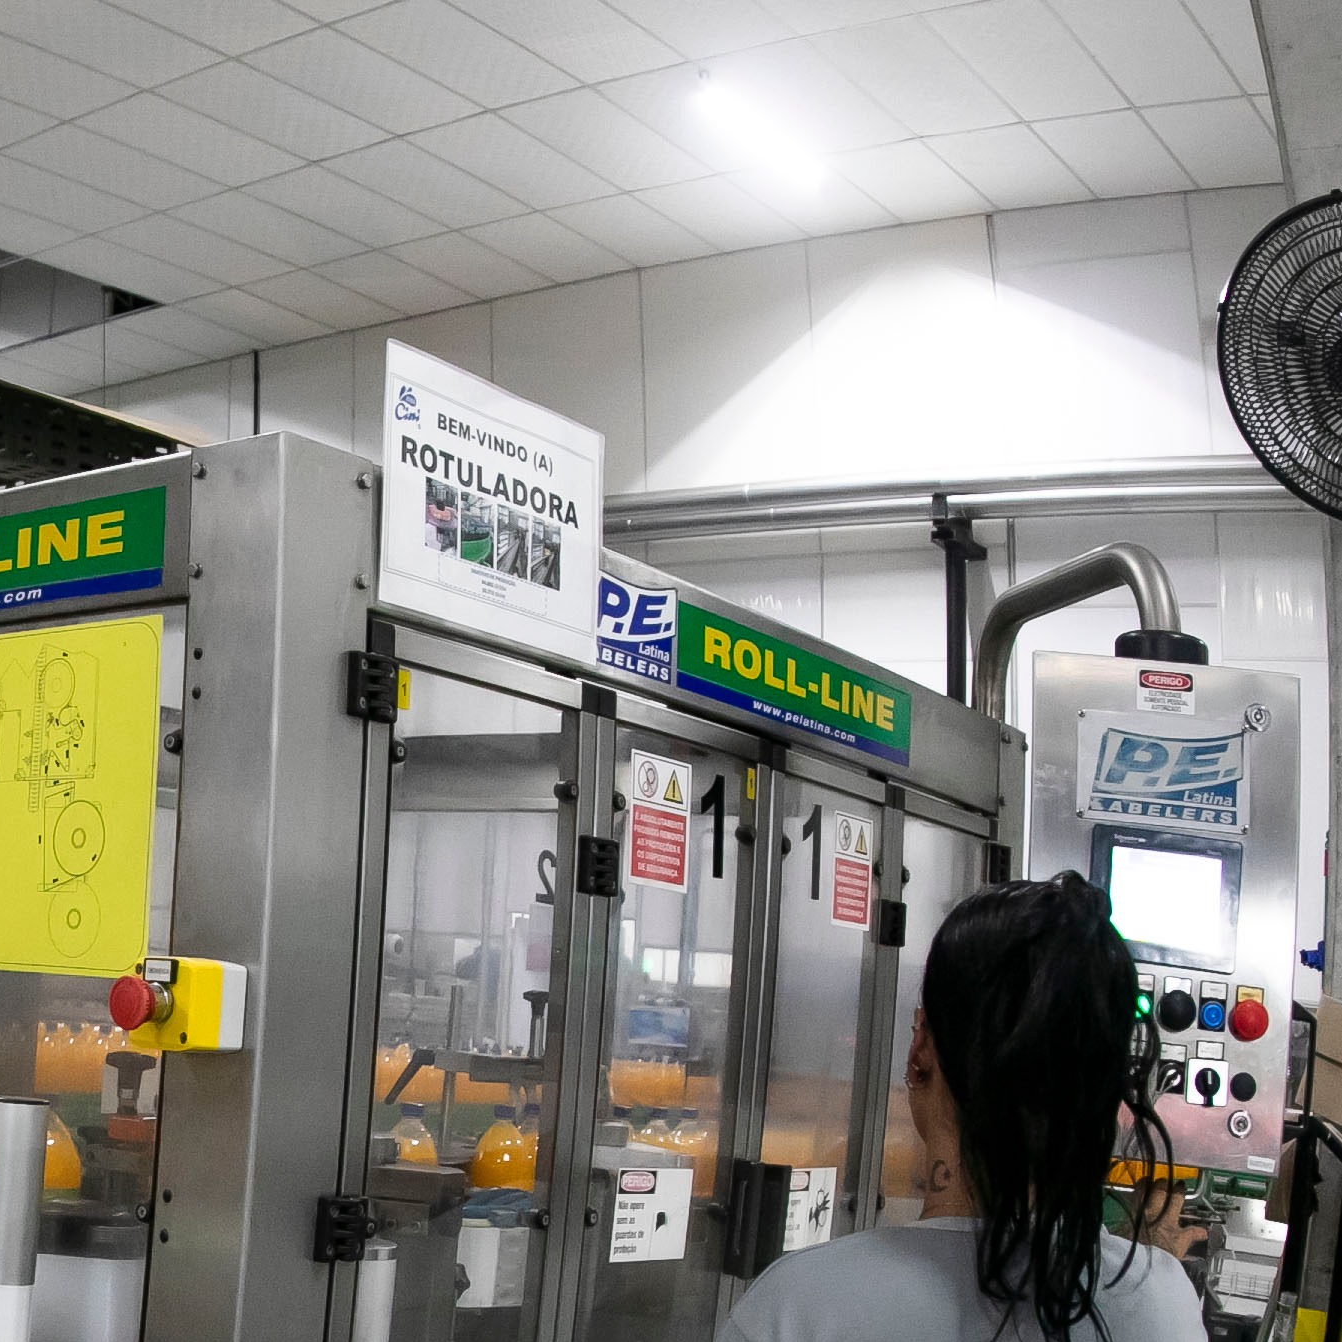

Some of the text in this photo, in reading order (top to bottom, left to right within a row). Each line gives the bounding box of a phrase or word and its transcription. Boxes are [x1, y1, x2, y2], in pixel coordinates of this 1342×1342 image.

[437, 412, 554, 477] BEM-VINDO (A)
[400, 434, 580, 530] ROTULADORA
[597, 646, 670, 681] BELERS
[638, 642, 670, 663] Latina
[704, 625, 895, 733] ROLL-LINE
[1148, 674, 1184, 687] PERIGO
[752, 698, 857, 744] www.pelatina.com
[1090, 797, 1234, 825] LABELERS
[1183, 790, 1233, 807] Latina
[700, 773, 726, 880] 1
[802, 803, 823, 901] 1
